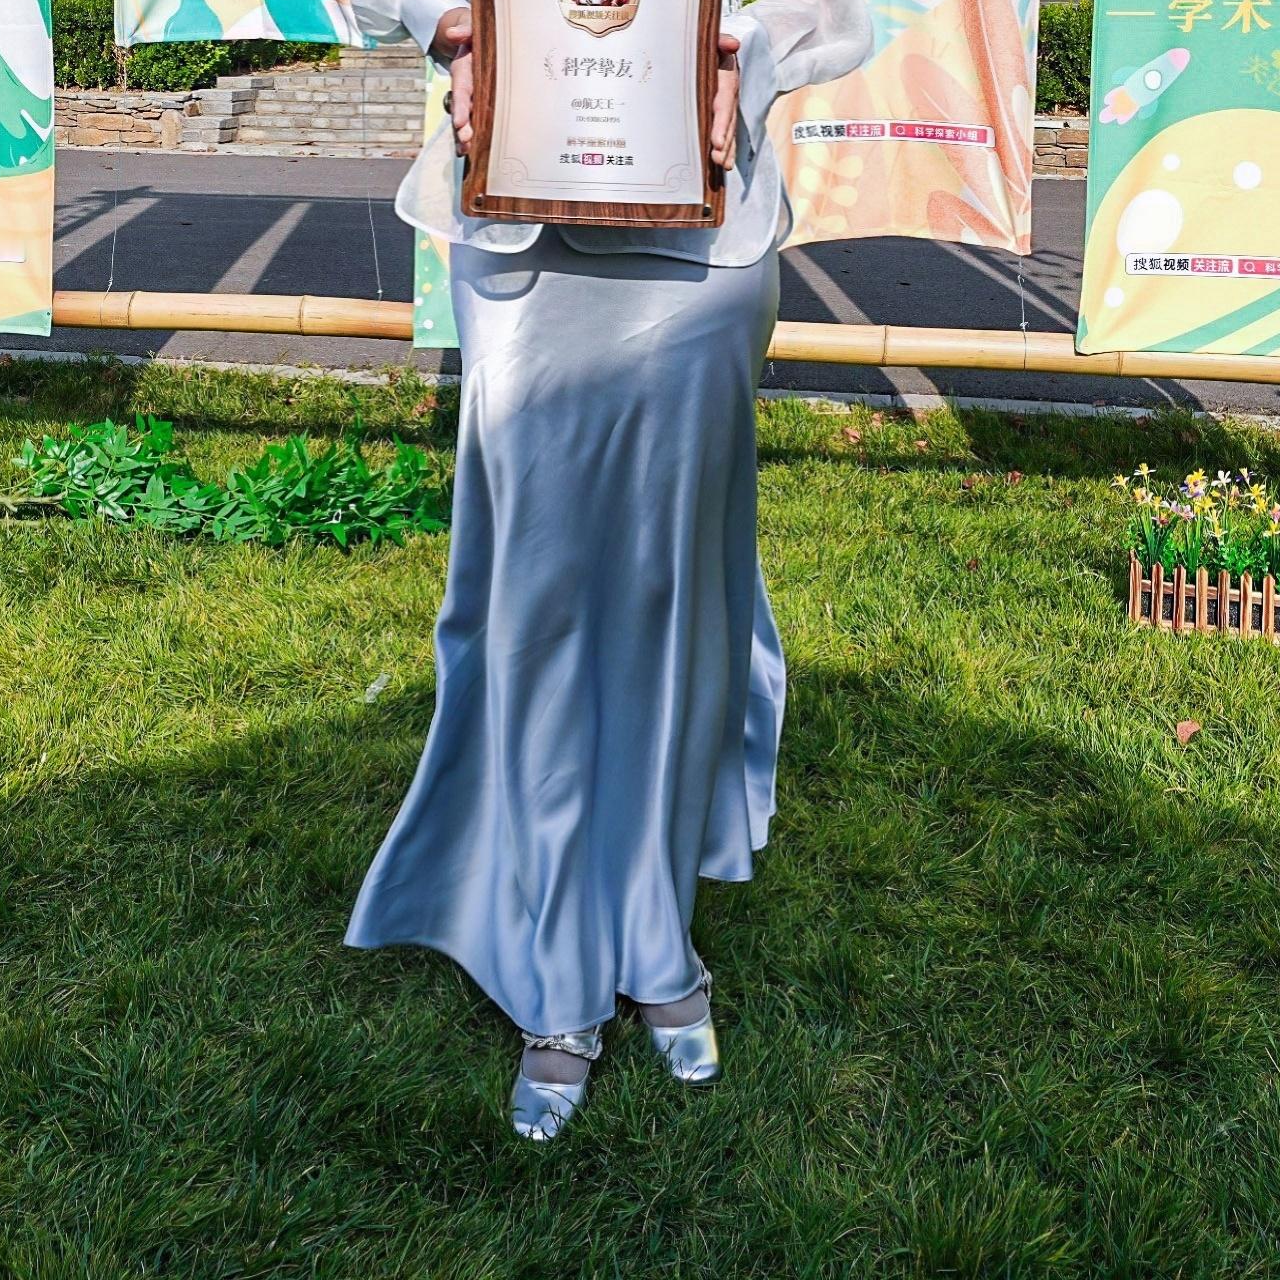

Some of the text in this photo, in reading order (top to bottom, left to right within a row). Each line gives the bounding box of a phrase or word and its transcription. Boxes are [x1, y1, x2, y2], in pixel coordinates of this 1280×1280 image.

[562, 56, 634, 78] 科学挚友
[794, 123, 979, 141] 搜狐视频关注流 科学探索小组
[1133, 257, 1231, 273] 搜狐视频关注流
